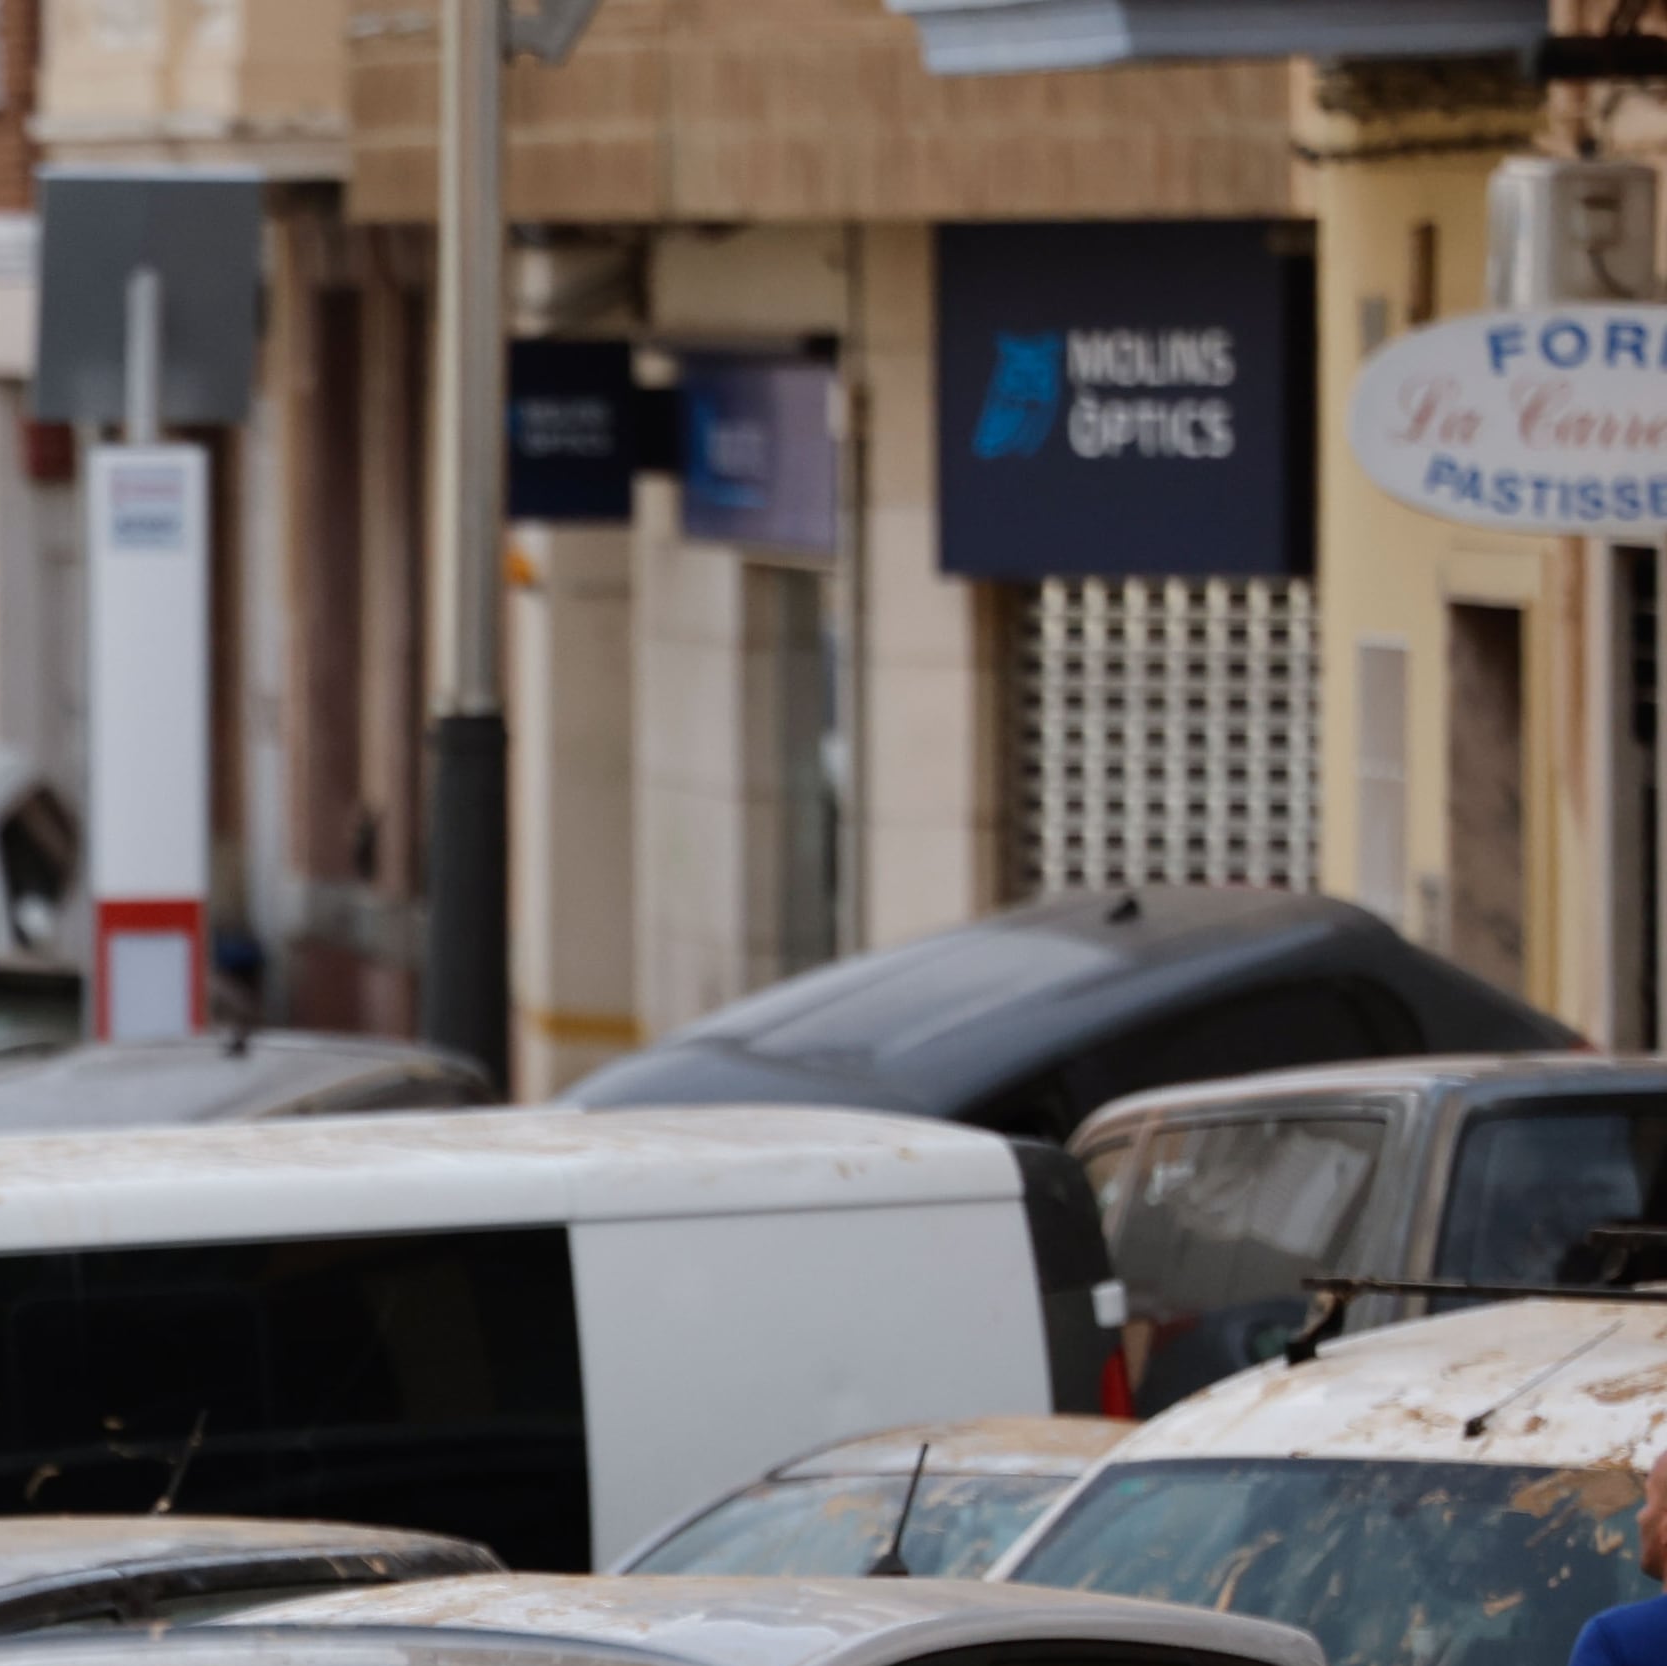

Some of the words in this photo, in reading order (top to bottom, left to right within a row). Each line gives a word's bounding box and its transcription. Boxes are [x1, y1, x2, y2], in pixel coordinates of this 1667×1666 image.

[1068, 326, 1236, 387] MOLINS
[1486, 318, 1667, 376] FOR
[1392, 374, 1481, 445] La
